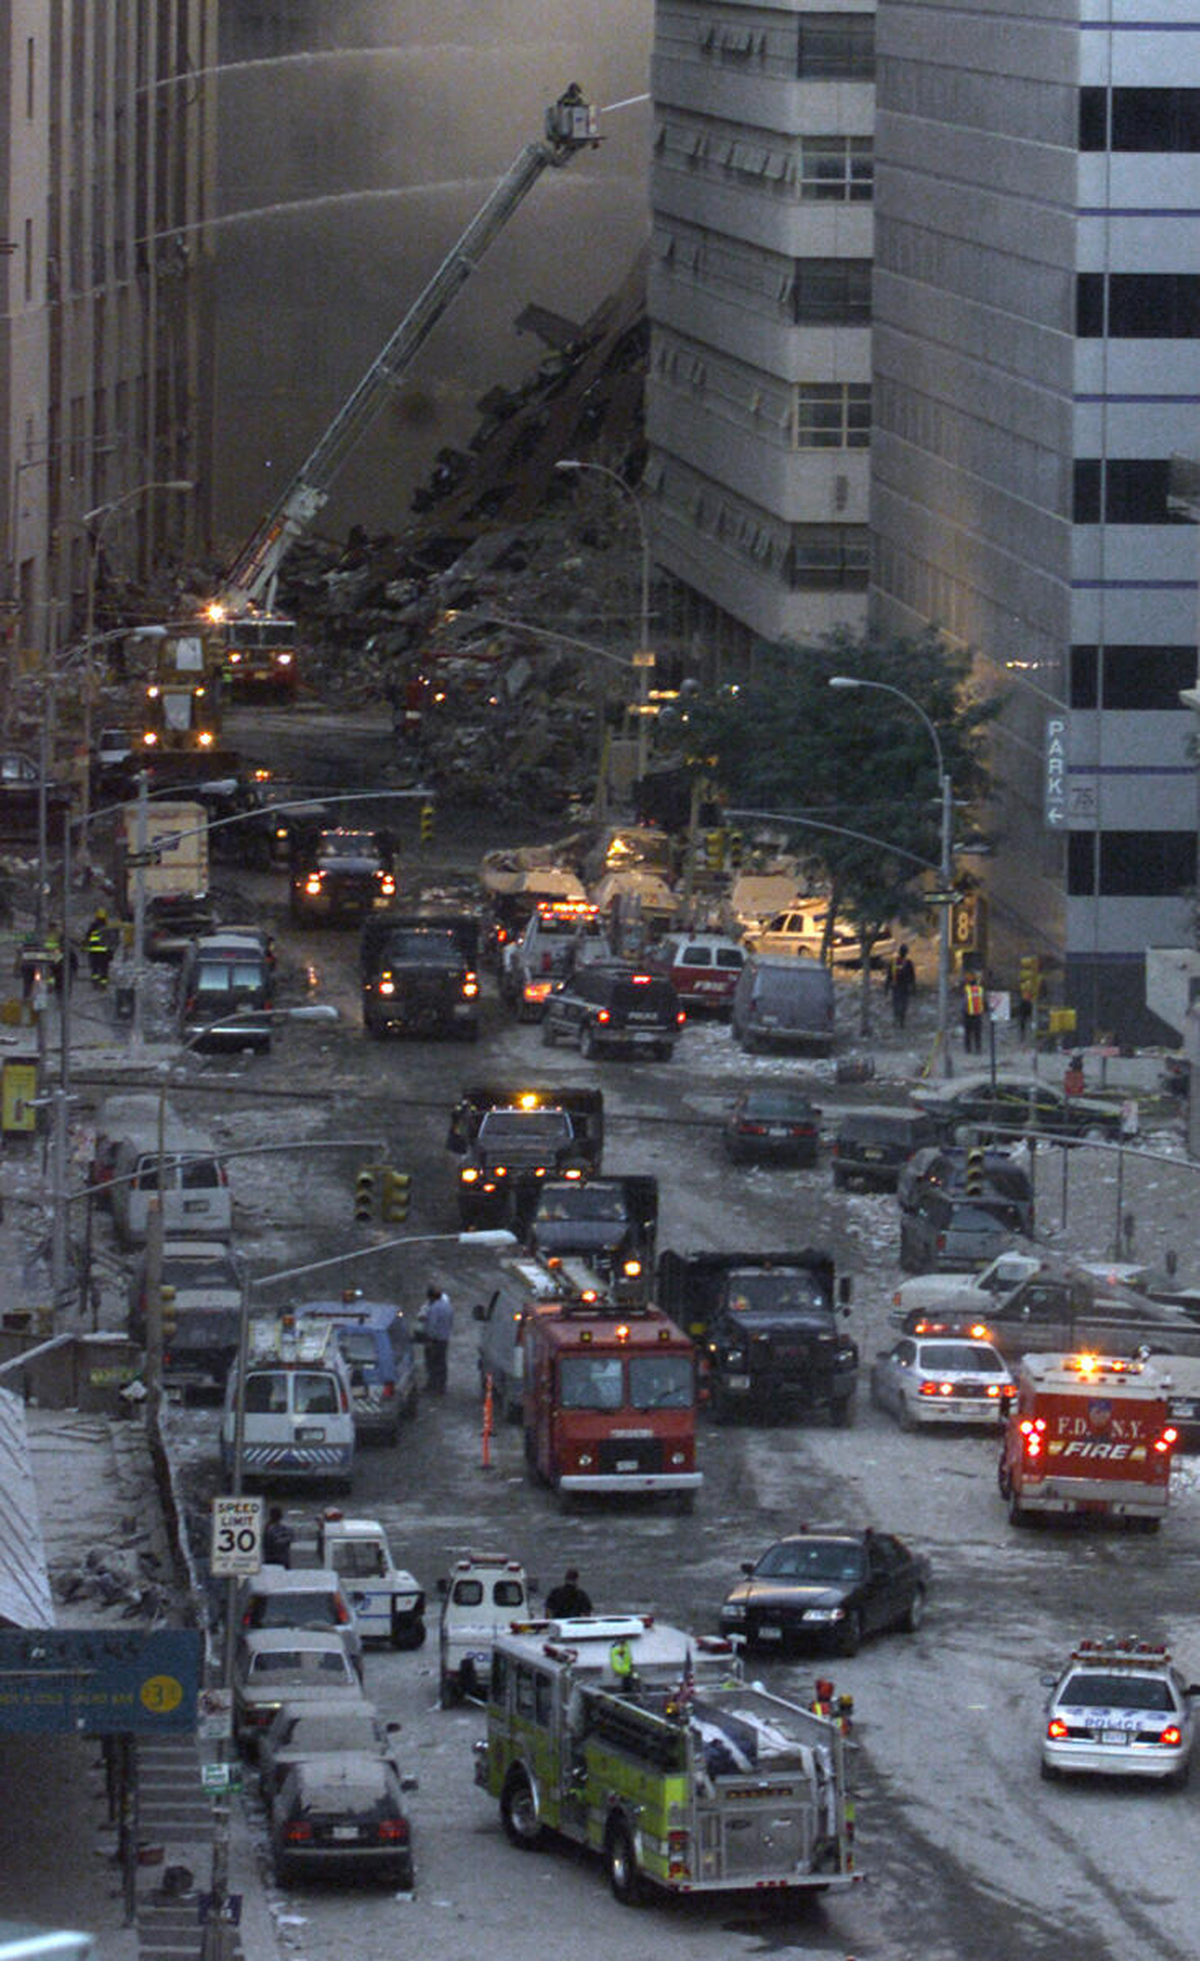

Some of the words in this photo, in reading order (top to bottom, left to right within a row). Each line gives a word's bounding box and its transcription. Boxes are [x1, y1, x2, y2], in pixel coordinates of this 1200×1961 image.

[1048, 720, 1065, 795] PARK
[1063, 1441, 1132, 1460] FIRE
[218, 1502, 260, 1514] SPEED
[221, 1515, 254, 1526] LIMIT
[217, 1528, 256, 1553] 30
[1085, 1717, 1143, 1732] POLICE
